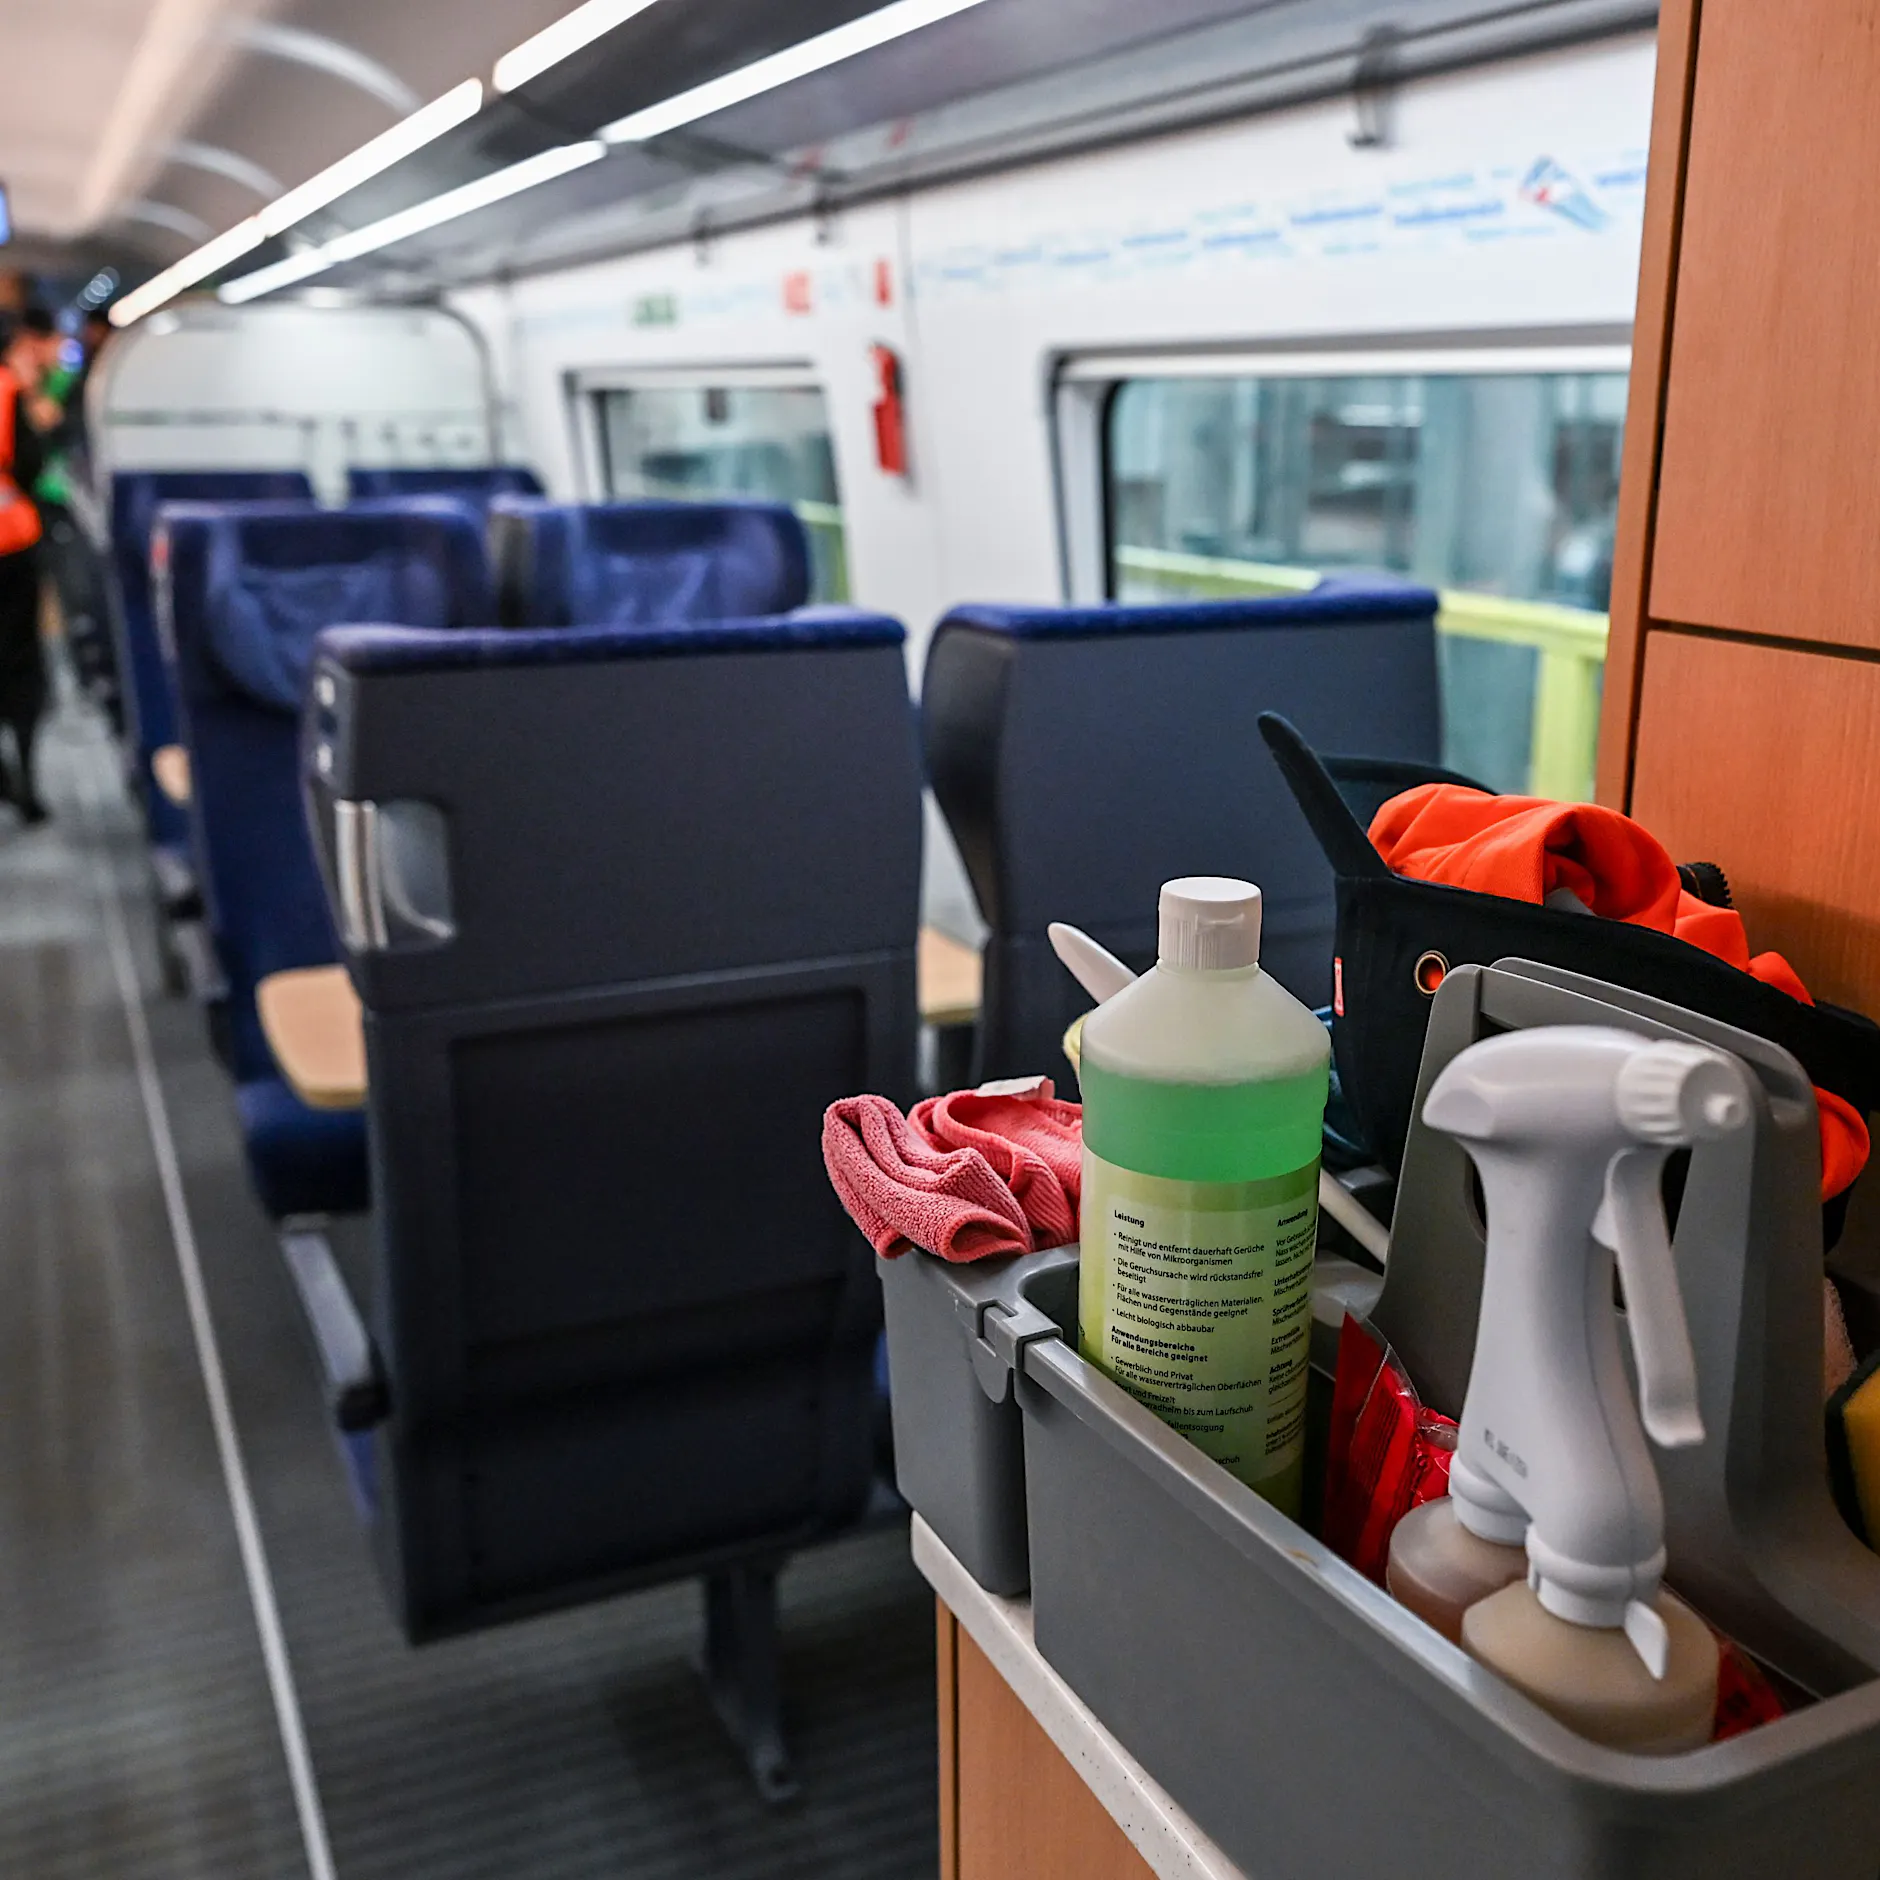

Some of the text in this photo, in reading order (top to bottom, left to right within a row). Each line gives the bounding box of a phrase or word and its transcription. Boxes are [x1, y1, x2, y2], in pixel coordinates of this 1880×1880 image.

[1114, 1210, 1144, 1228] Leistung
[1118, 1232, 1265, 1256] Reinigt und entfernt dauerhaft Gerüche
[1118, 1242, 1232, 1267] mit Hilfe von Mikroorganismen
[1117, 1266, 1146, 1284] beseitigt
[1118, 1258, 1263, 1282] Die Geruchsursache wird rückstandsfrei
[1117, 1282, 1127, 1293] Für
[1128, 1286, 1140, 1297] alle
[1142, 1290, 1219, 1309] wasserverträglichen
[1117, 1293, 1248, 1319] Flächen und Gegenstände geeignet
[1117, 1308, 1214, 1333] Leicht biologisch abbaubar
[1111, 1335, 1208, 1363] Für alle Bereiche geeignet
[1112, 1325, 1195, 1352] Anwendungsbereiche
[1115, 1357, 1194, 1381] Gewerblich und Privat
[1115, 1366, 1262, 1392] Für alle wasserverträglichen Oberflächen
[1133, 1388, 1147, 1399] und
[1148, 1392, 1176, 1404] Freizeit
[1184, 1407, 1195, 1416] bis
[1215, 1404, 1253, 1416] Laufschuh
